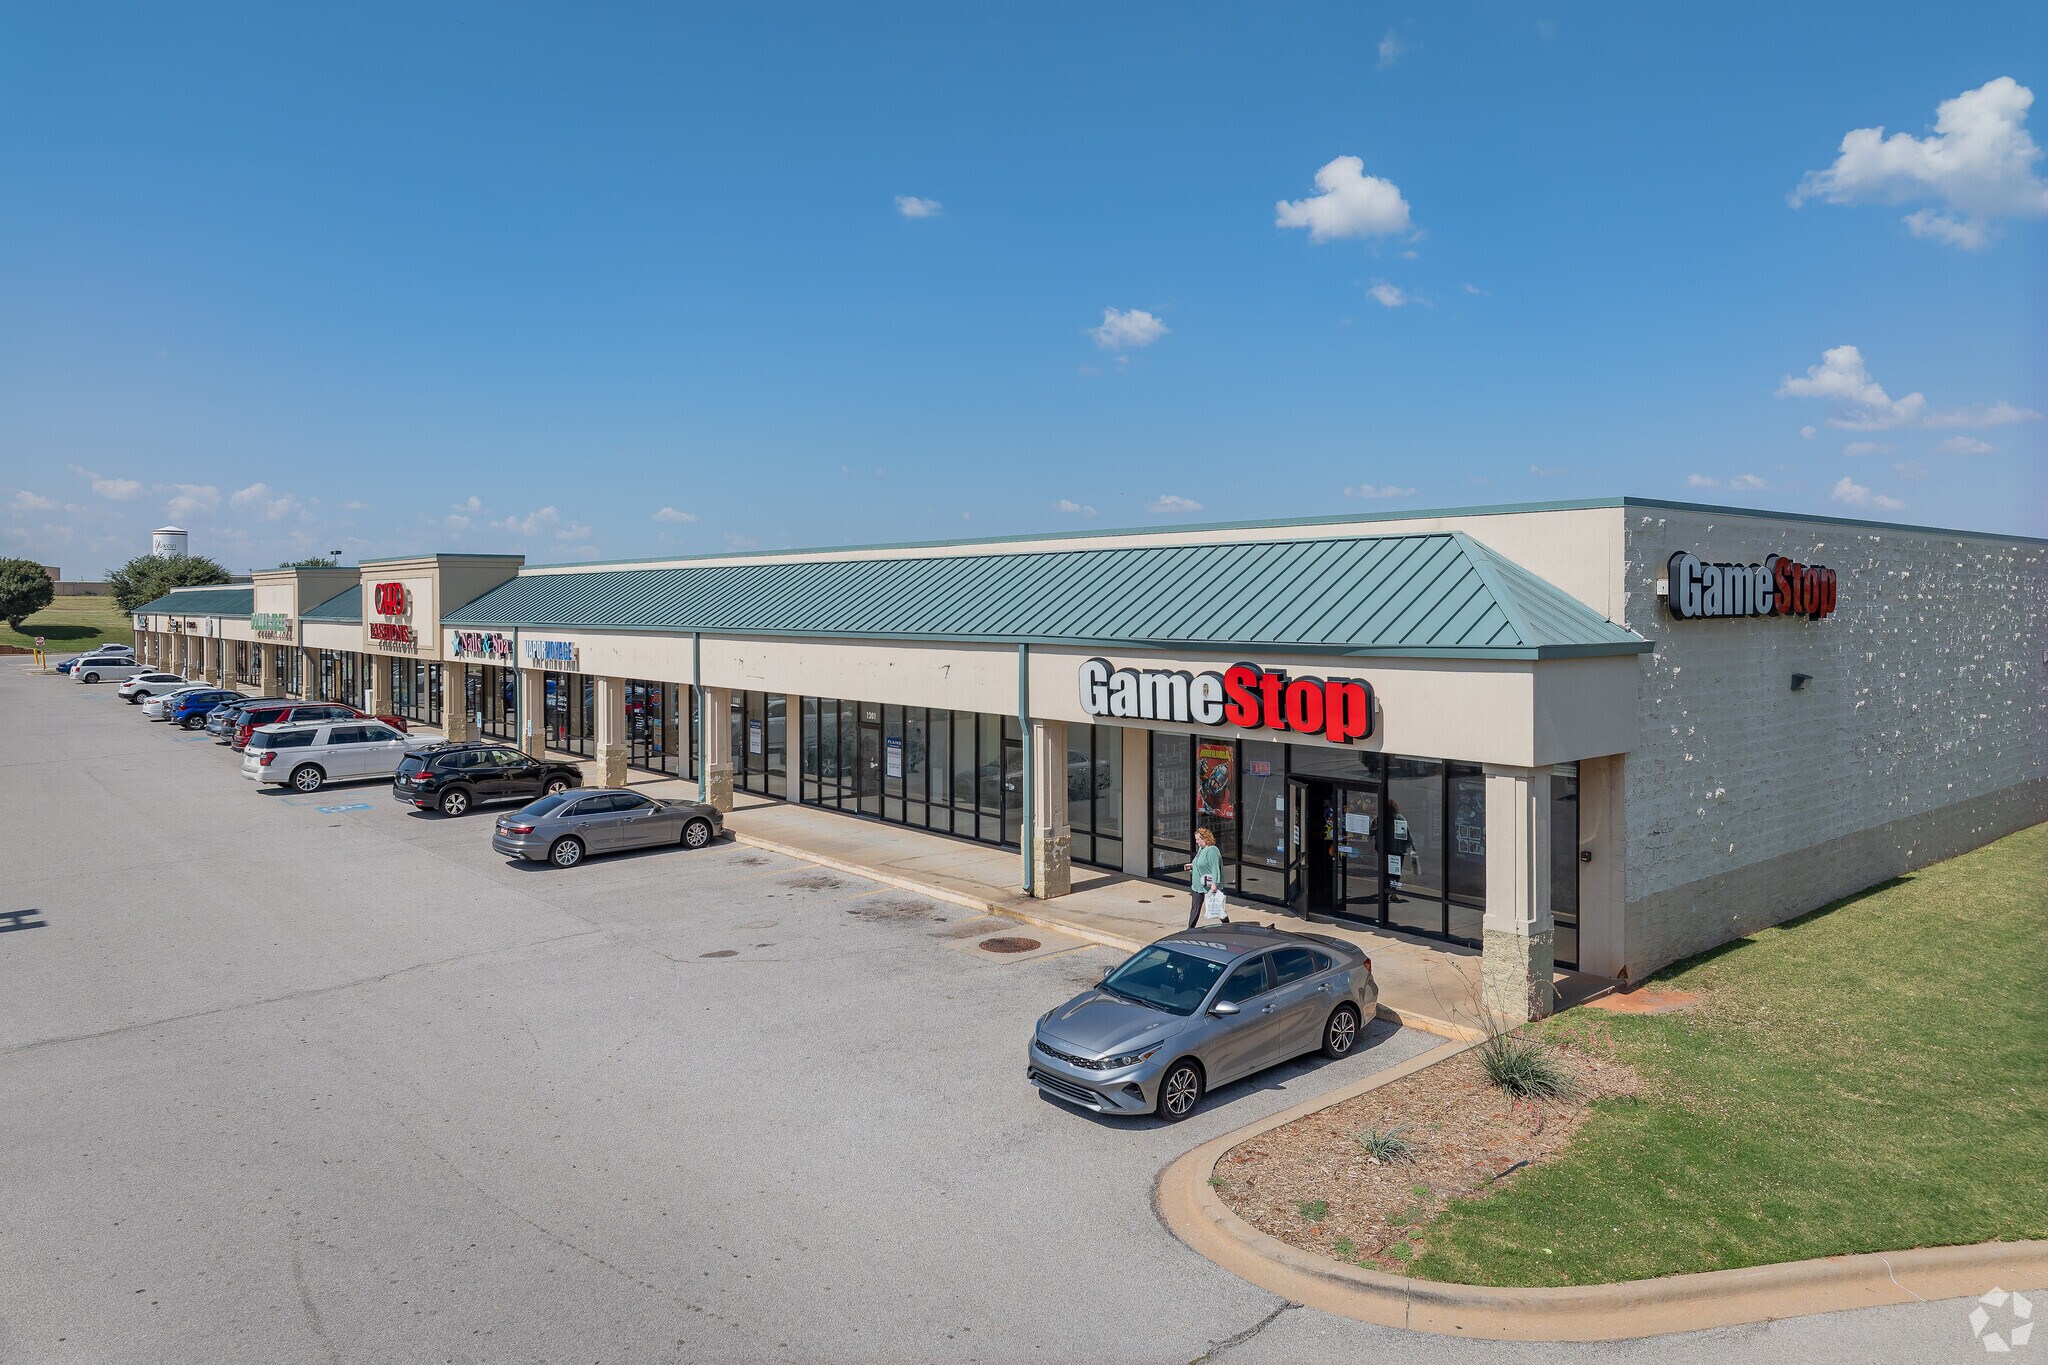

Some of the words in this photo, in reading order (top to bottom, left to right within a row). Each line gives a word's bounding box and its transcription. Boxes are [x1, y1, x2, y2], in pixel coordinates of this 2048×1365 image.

[154, 539, 177, 551] Yukon
[1679, 553, 1837, 618] GameStop
[370, 623, 409, 642] FASHIONS
[461, 632, 482, 653] Nails
[482, 633, 491, 653] &
[492, 634, 510, 655] Spa
[1078, 658, 1368, 743] GameStop
